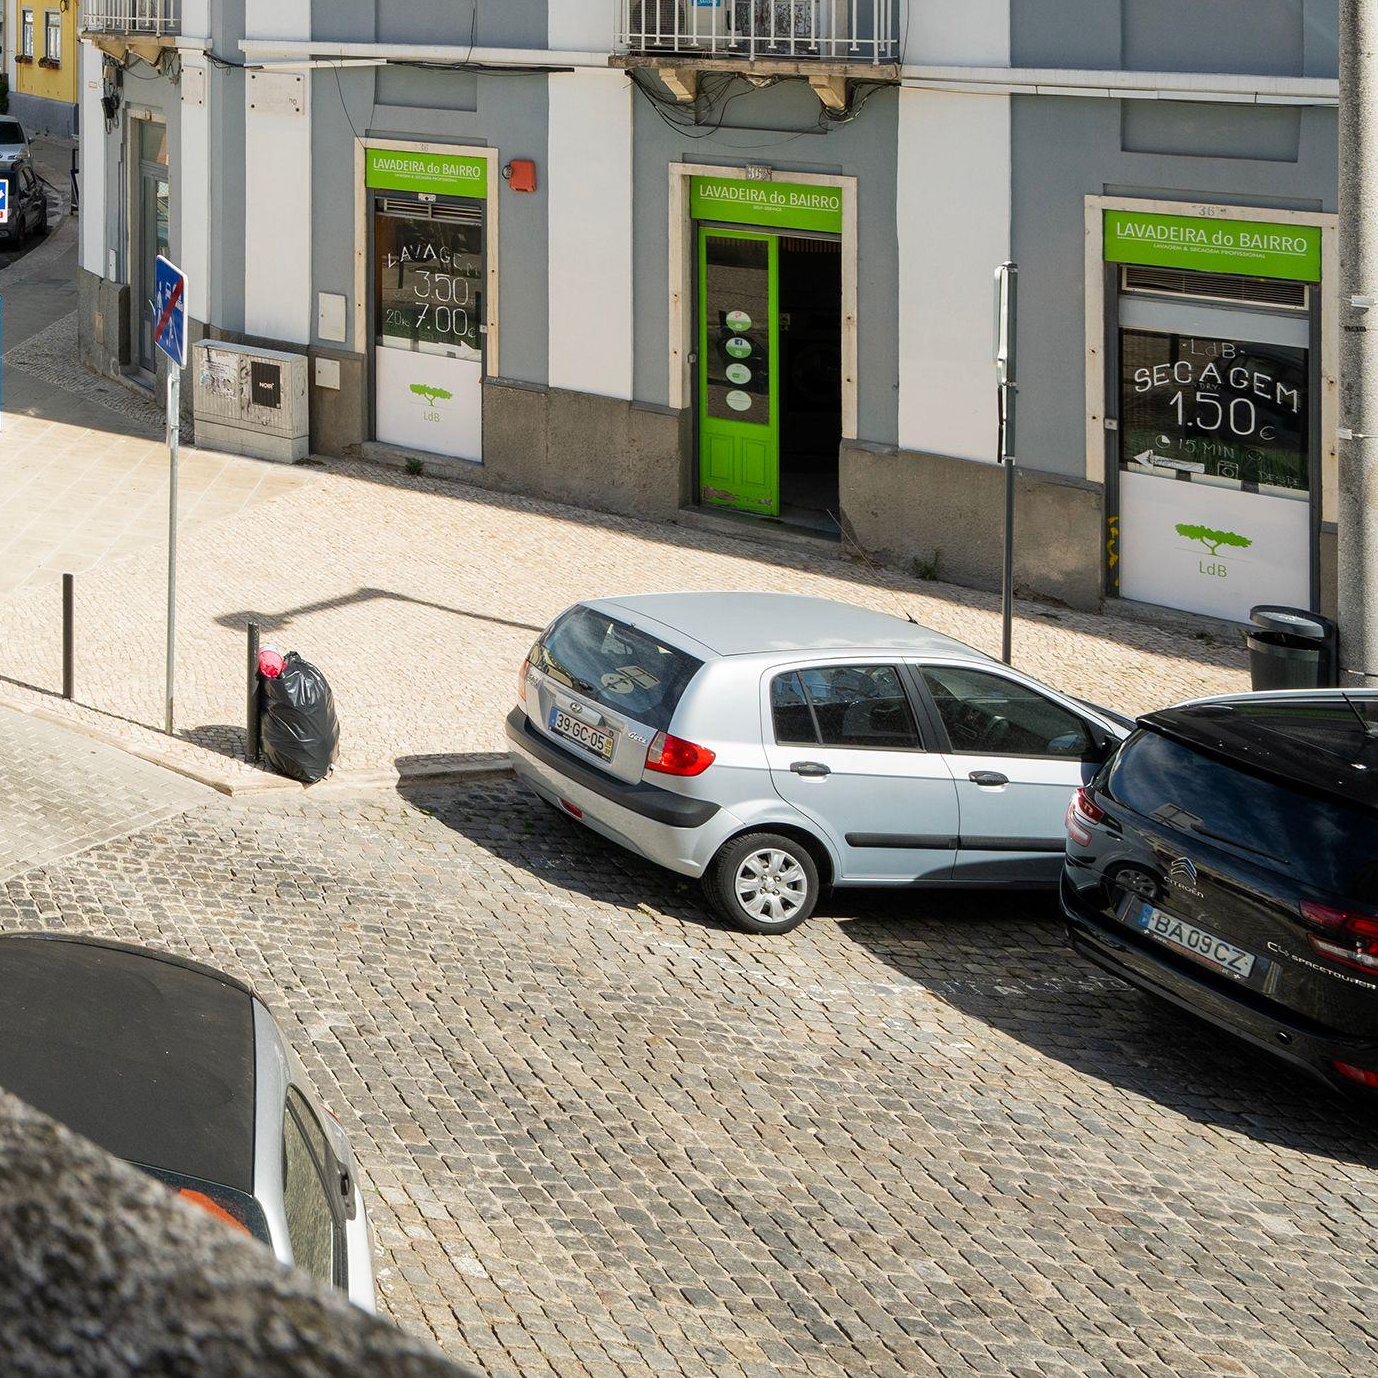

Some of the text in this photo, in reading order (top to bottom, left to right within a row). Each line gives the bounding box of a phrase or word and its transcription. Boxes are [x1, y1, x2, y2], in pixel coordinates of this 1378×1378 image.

[373, 158, 481, 178] LAVADEIRA do BAIRRO
[699, 184, 839, 209] LAVADEIRA do BAIRRO
[1116, 222, 1308, 253] LAVADEIRA do BAIRRO
[414, 270, 469, 305] 3.50
[1134, 360, 1302, 413] SECAGEM
[423, 410, 440, 423] LdB
[1179, 438, 1235, 459] 15 MIN
[1199, 560, 1228, 578] LdB
